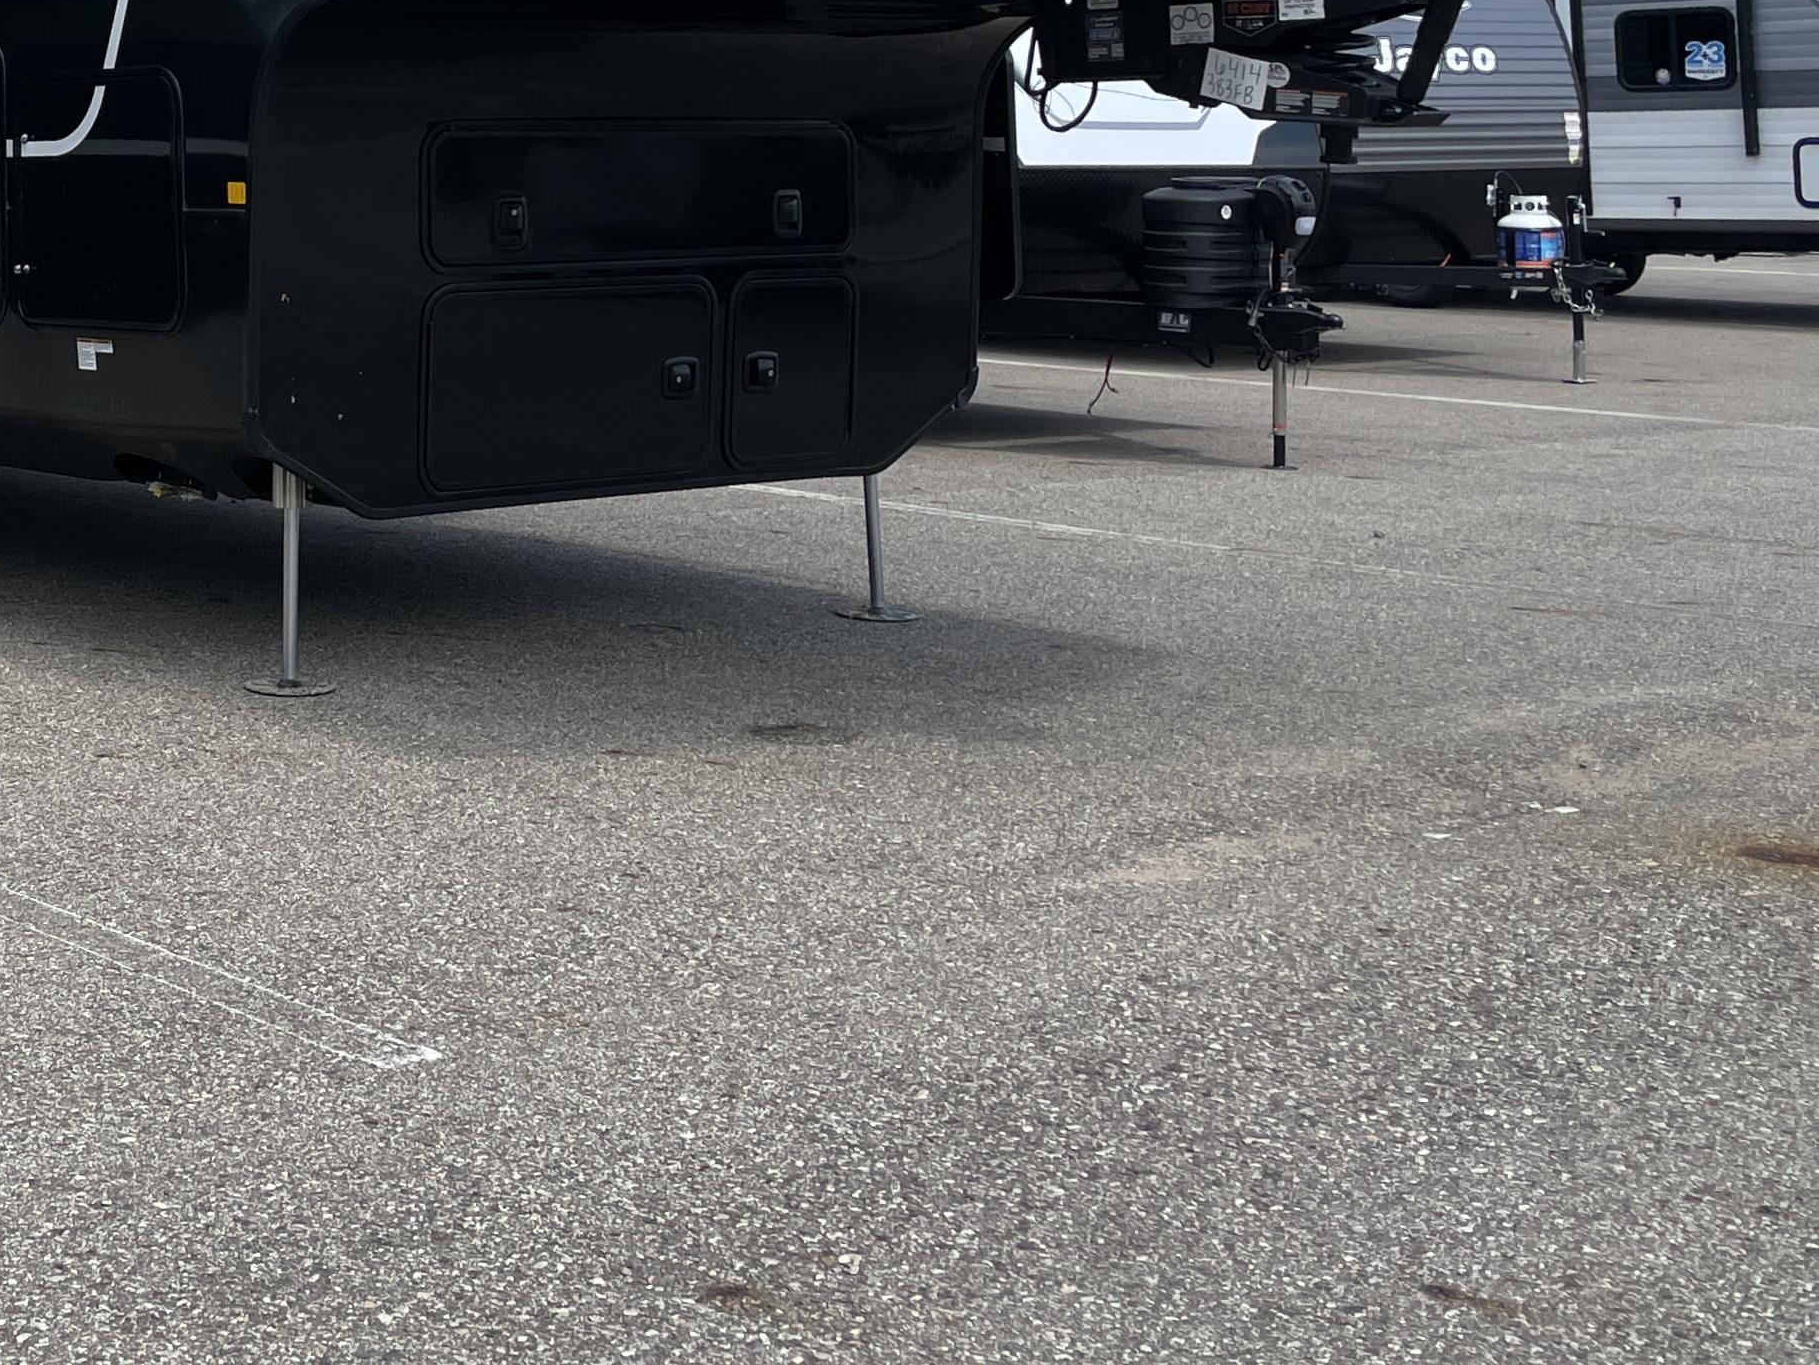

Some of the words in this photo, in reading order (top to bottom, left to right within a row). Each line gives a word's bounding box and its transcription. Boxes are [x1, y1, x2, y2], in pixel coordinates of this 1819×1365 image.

[1214, 54, 1262, 85] 6414
[1373, 36, 1498, 82] Jaco
[1205, 73, 1254, 105] 383FB
